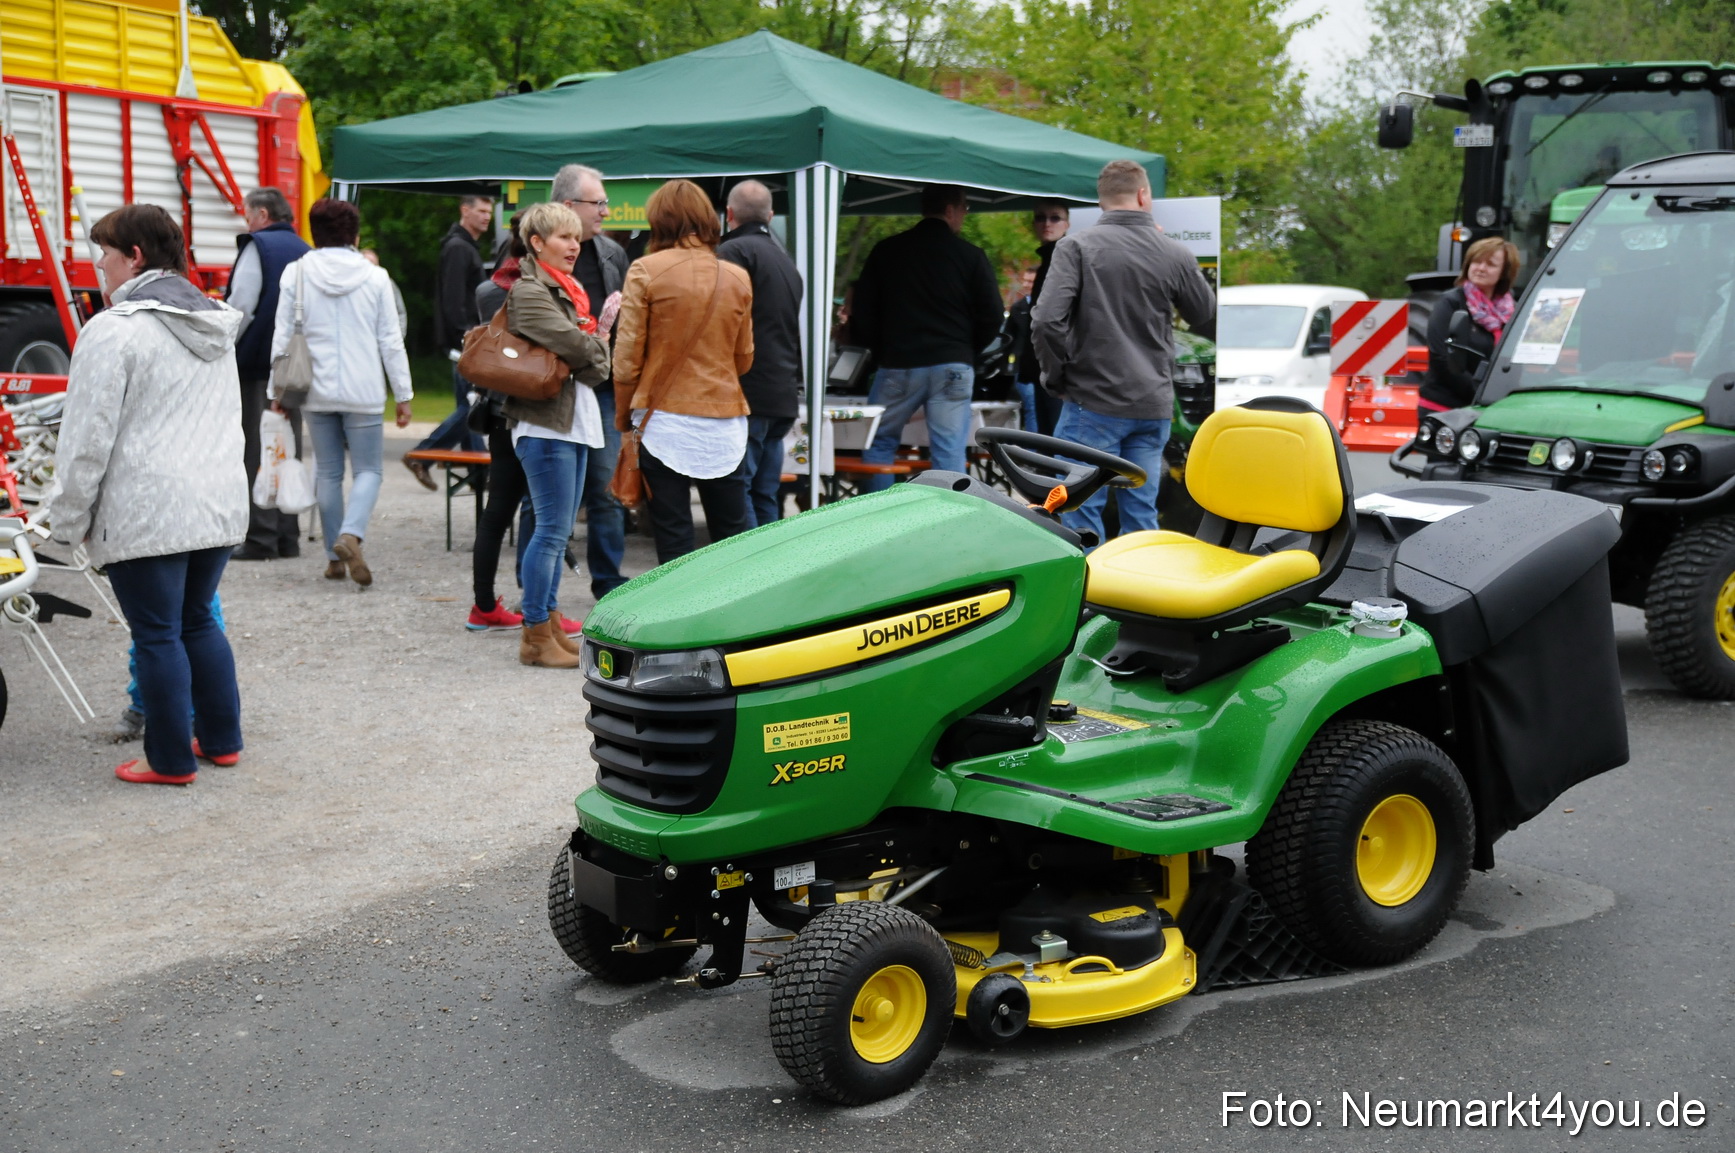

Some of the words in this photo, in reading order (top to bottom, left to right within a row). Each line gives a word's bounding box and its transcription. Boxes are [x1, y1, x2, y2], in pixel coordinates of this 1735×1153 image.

[1183, 230, 1211, 241] DEERE
[857, 620, 914, 651] JOHN
[915, 601, 981, 634] DEERE
[766, 725, 787, 734] D.O.B.
[789, 718, 830, 730] Landtechnik
[769, 754, 846, 785] X305R
[776, 877, 787, 887] 100
